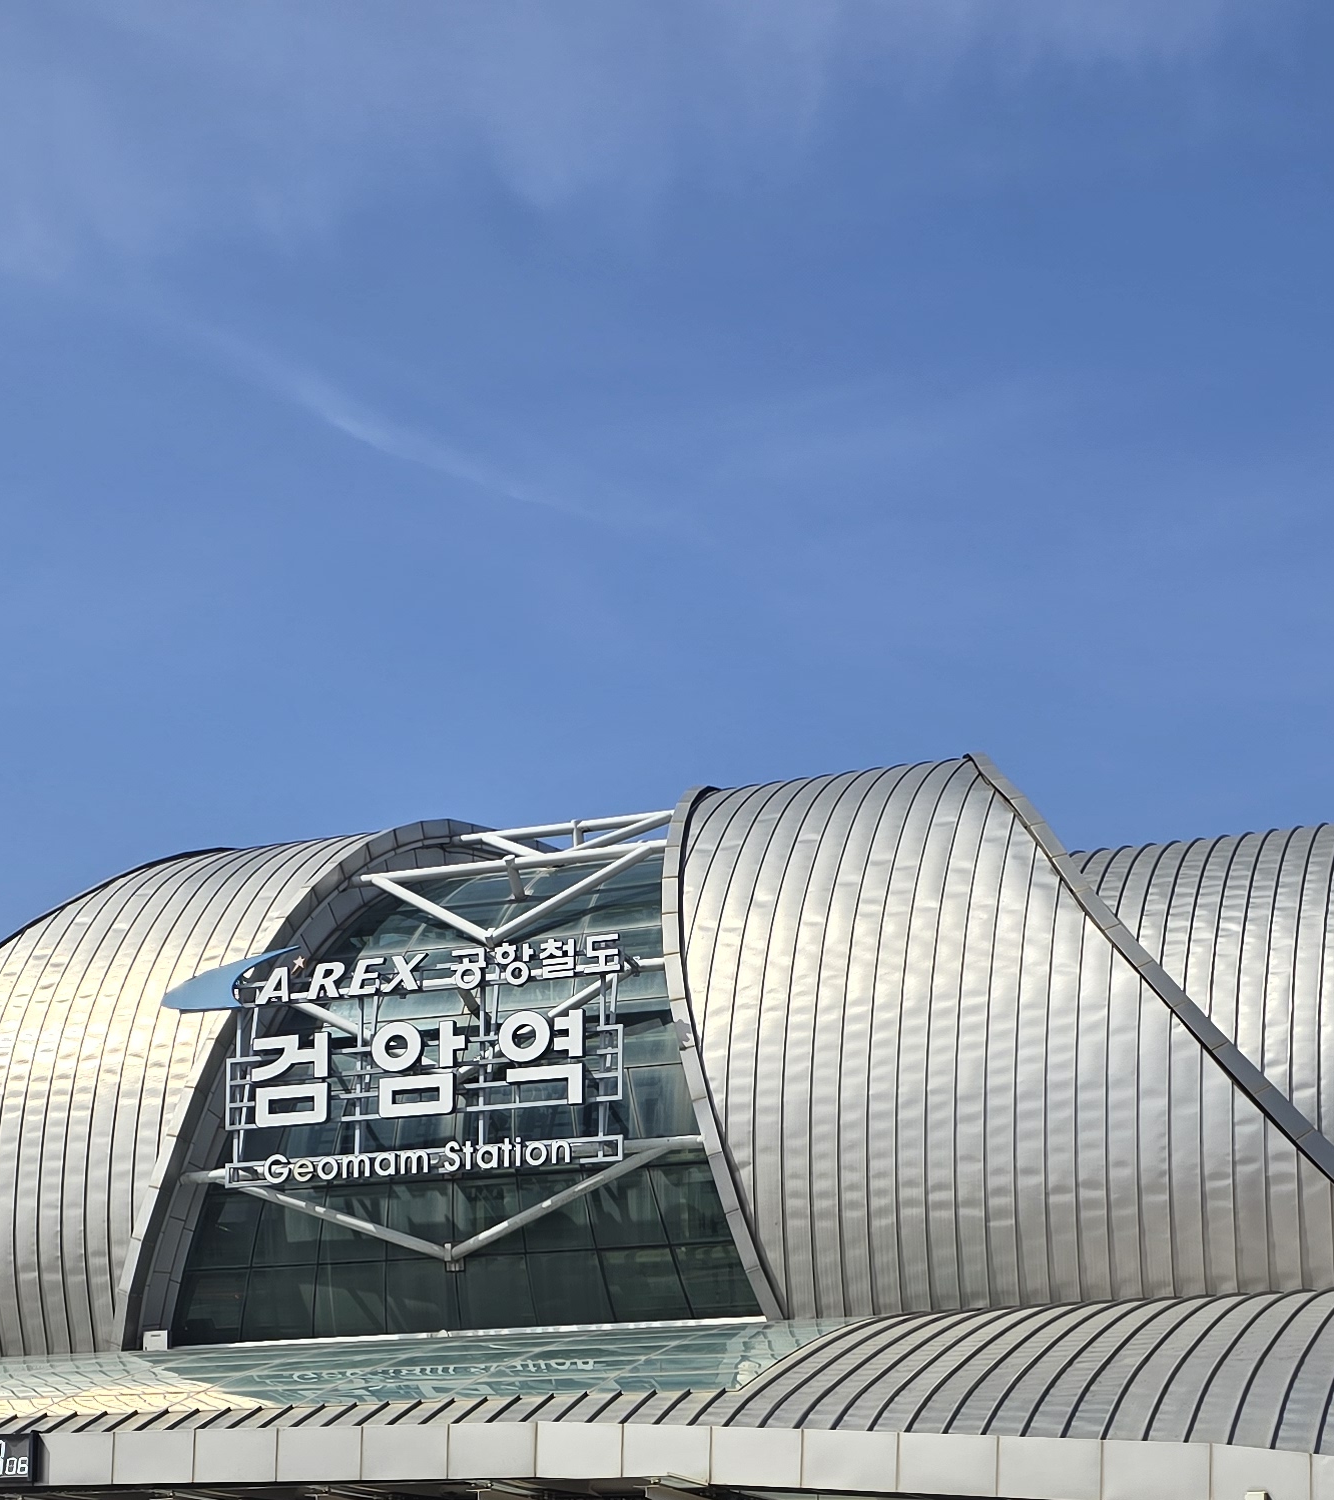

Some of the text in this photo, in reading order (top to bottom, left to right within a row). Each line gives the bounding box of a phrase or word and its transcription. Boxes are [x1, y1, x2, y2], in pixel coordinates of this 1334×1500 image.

[255, 934, 620, 1005] AREX 공항철도
[251, 1008, 586, 1128] 검암역
[263, 1137, 572, 1184] Geomam Station
[6, 1457, 28, 1475] 06
